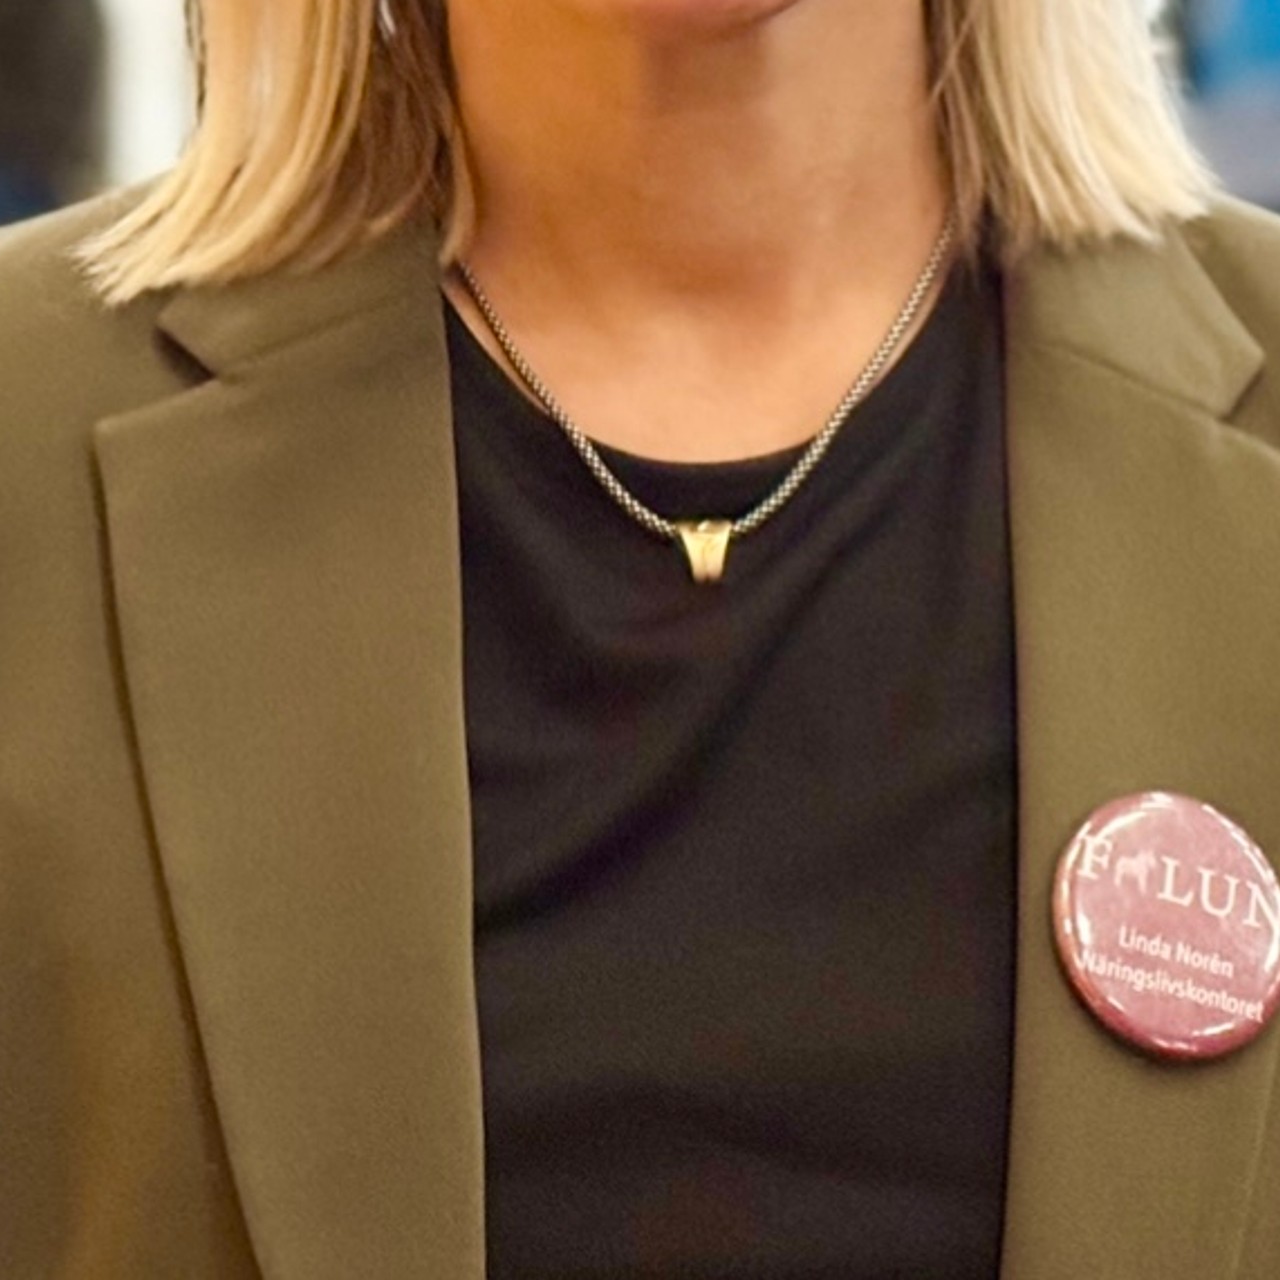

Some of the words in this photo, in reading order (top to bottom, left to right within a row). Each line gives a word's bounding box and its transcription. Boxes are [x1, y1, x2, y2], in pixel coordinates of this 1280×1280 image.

[1119, 924, 1170, 960] Linda
[1176, 941, 1234, 979] Norén
[1081, 949, 1265, 1023] Näringslivskontoret
